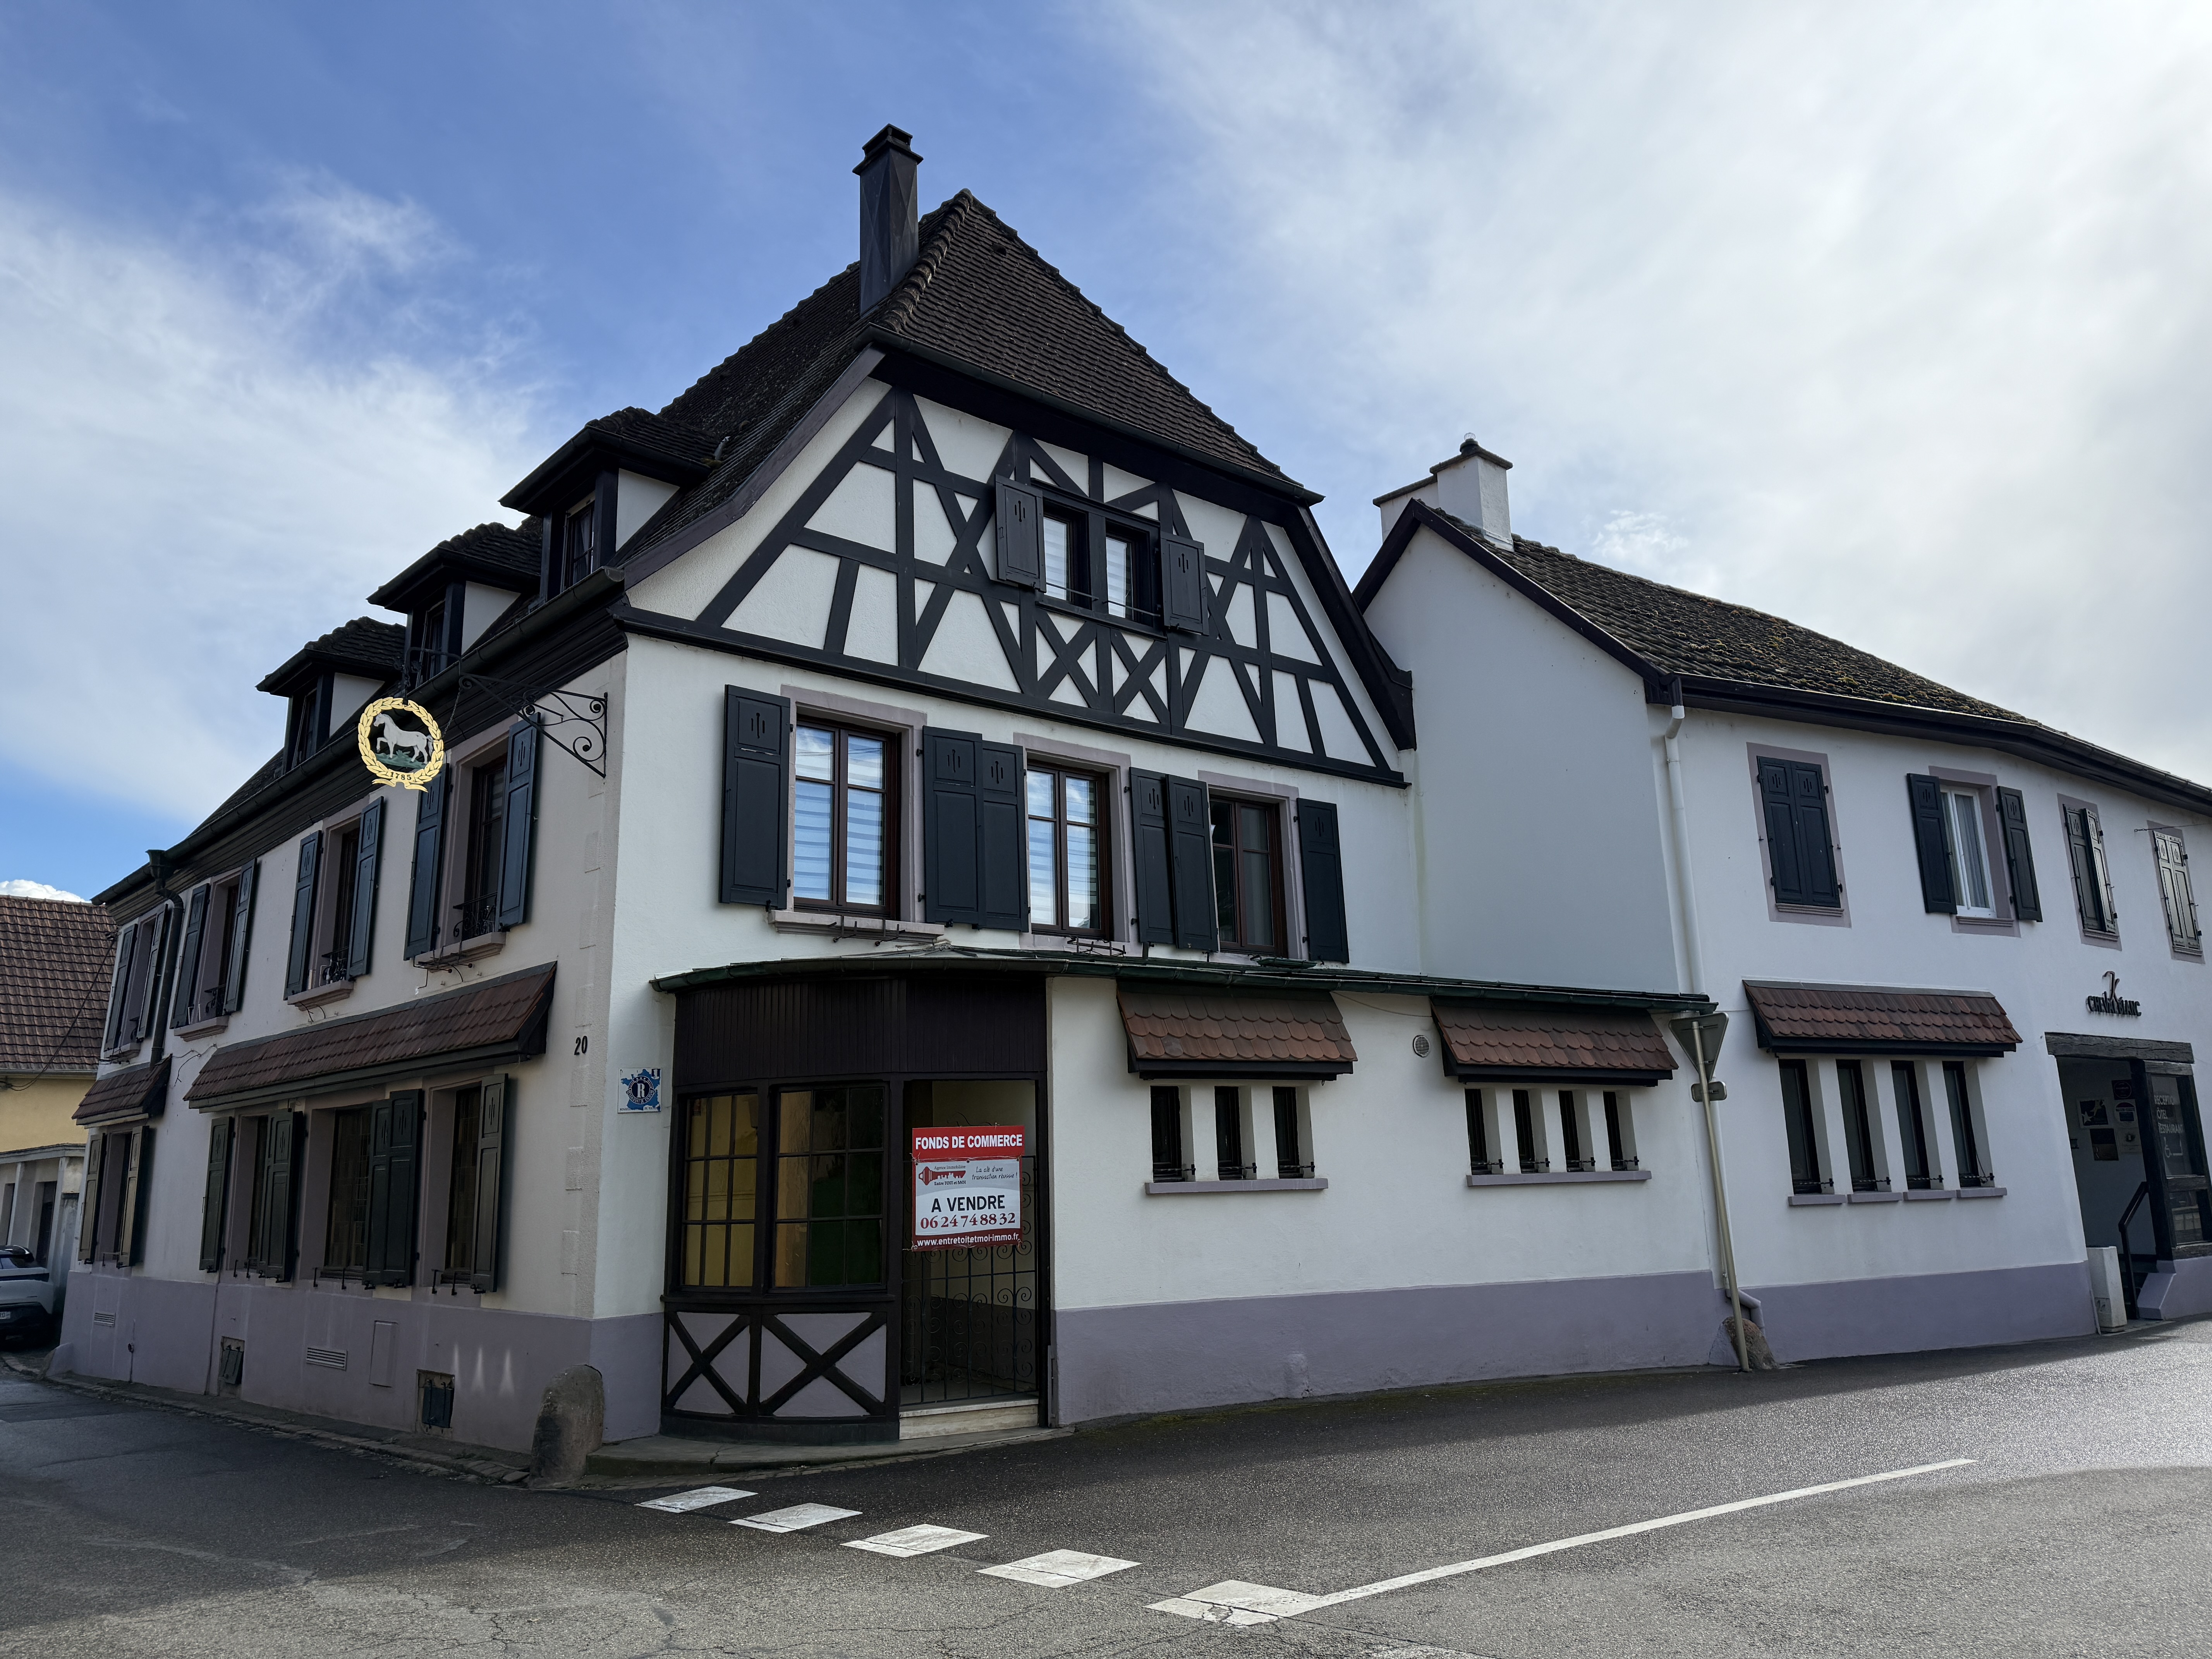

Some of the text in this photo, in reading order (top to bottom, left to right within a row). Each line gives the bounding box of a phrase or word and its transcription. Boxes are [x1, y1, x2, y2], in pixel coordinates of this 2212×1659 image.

[390, 772, 412, 780] 1785
[574, 1036, 588, 1055] 20
[636, 1083, 646, 1098] R
[915, 1134, 1022, 1150] FONDS DE COMMERCE
[931, 1195, 1005, 1212] A VENDRE
[920, 1212, 1015, 1229] 06 24 74 88 32
[917, 1233, 1019, 1246] www.entretoitetmoi-immo.fr
